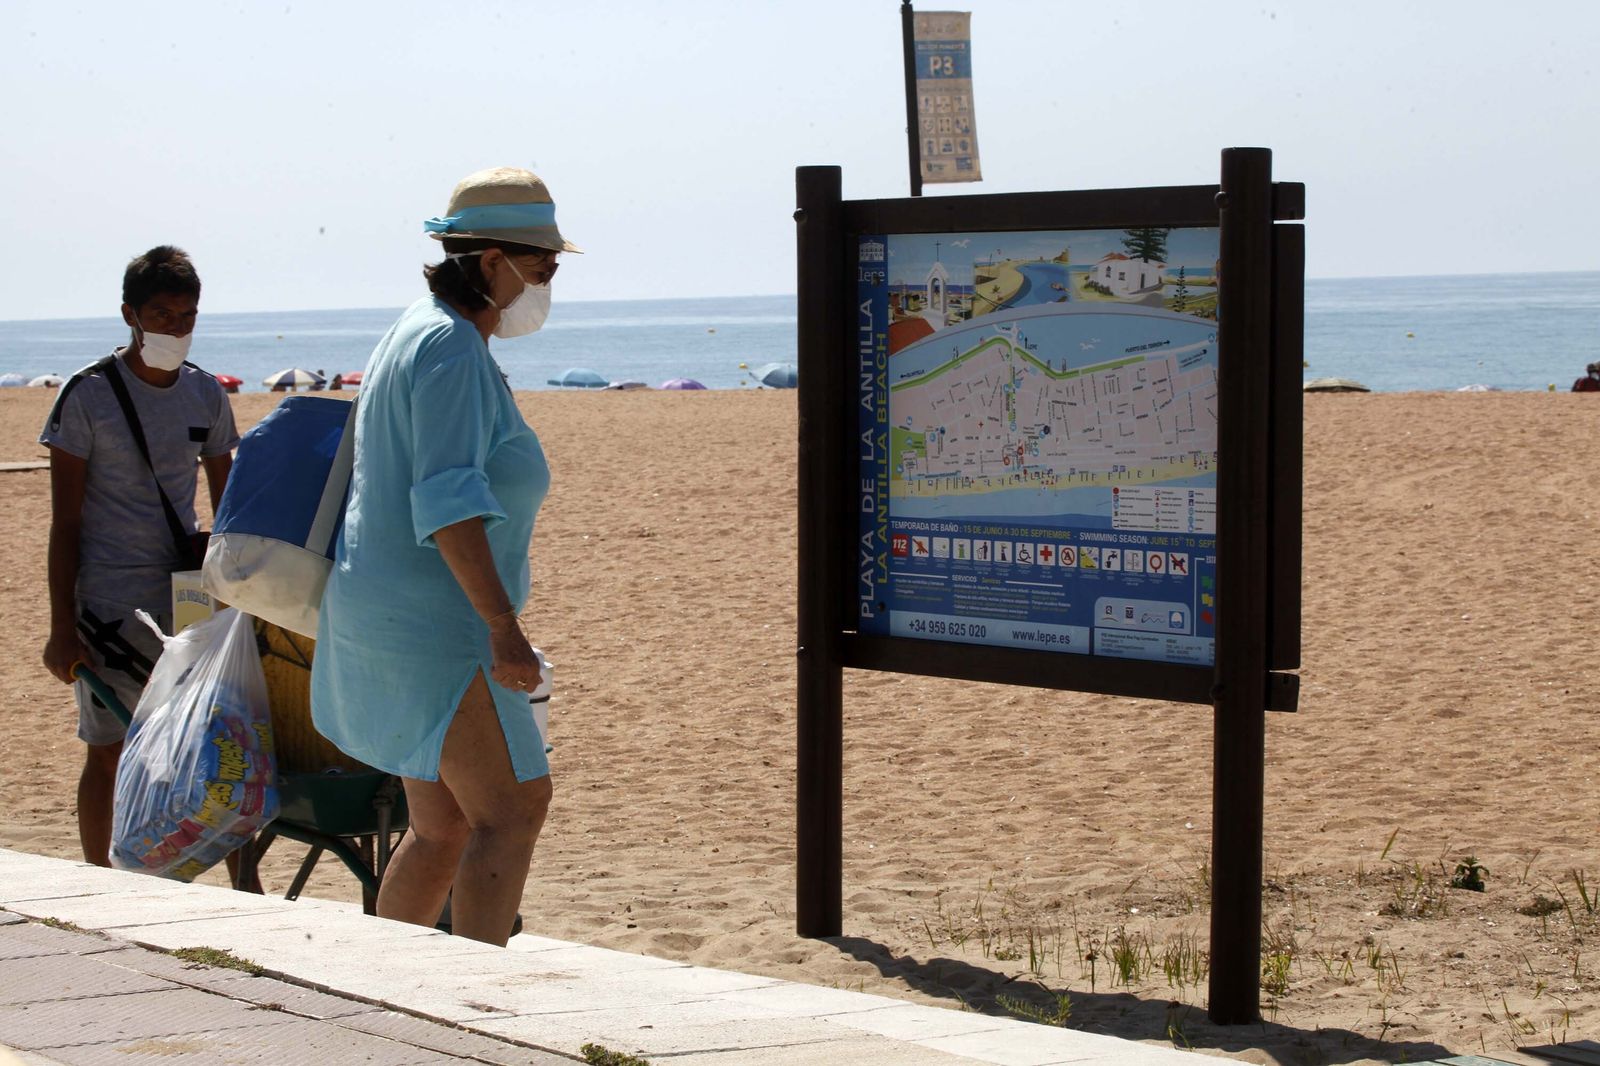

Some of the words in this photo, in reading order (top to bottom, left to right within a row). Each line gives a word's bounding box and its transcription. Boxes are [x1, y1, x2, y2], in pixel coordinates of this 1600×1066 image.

[930, 55, 953, 76] P3
[860, 299, 874, 412] ANTILLA
[876, 333, 888, 423] BEACH
[862, 428, 874, 461] LA
[862, 478, 874, 513] DE
[877, 432, 888, 543] ANTILLA
[890, 520, 929, 531] TEMPORADA
[930, 522, 940, 531] DE
[973, 525, 981, 534] DE
[983, 525, 1002, 535] JUNIO
[1004, 527, 1009, 536] A
[1010, 527, 1019, 536] 30
[1021, 528, 1029, 537] DE
[1031, 529, 1071, 539] SEPTIEMBRE
[1080, 532, 1118, 543] SWIMMING
[1150, 535, 1168, 546] JUNE
[893, 539, 908, 549] 112
[861, 530, 875, 618] PLAYA
[877, 551, 888, 584] LA
[908, 619, 926, 633] +34
[929, 620, 946, 634] 959
[948, 622, 966, 636] 625
[968, 624, 986, 638] 020
[1012, 629, 1071, 646] www.lepe.es
